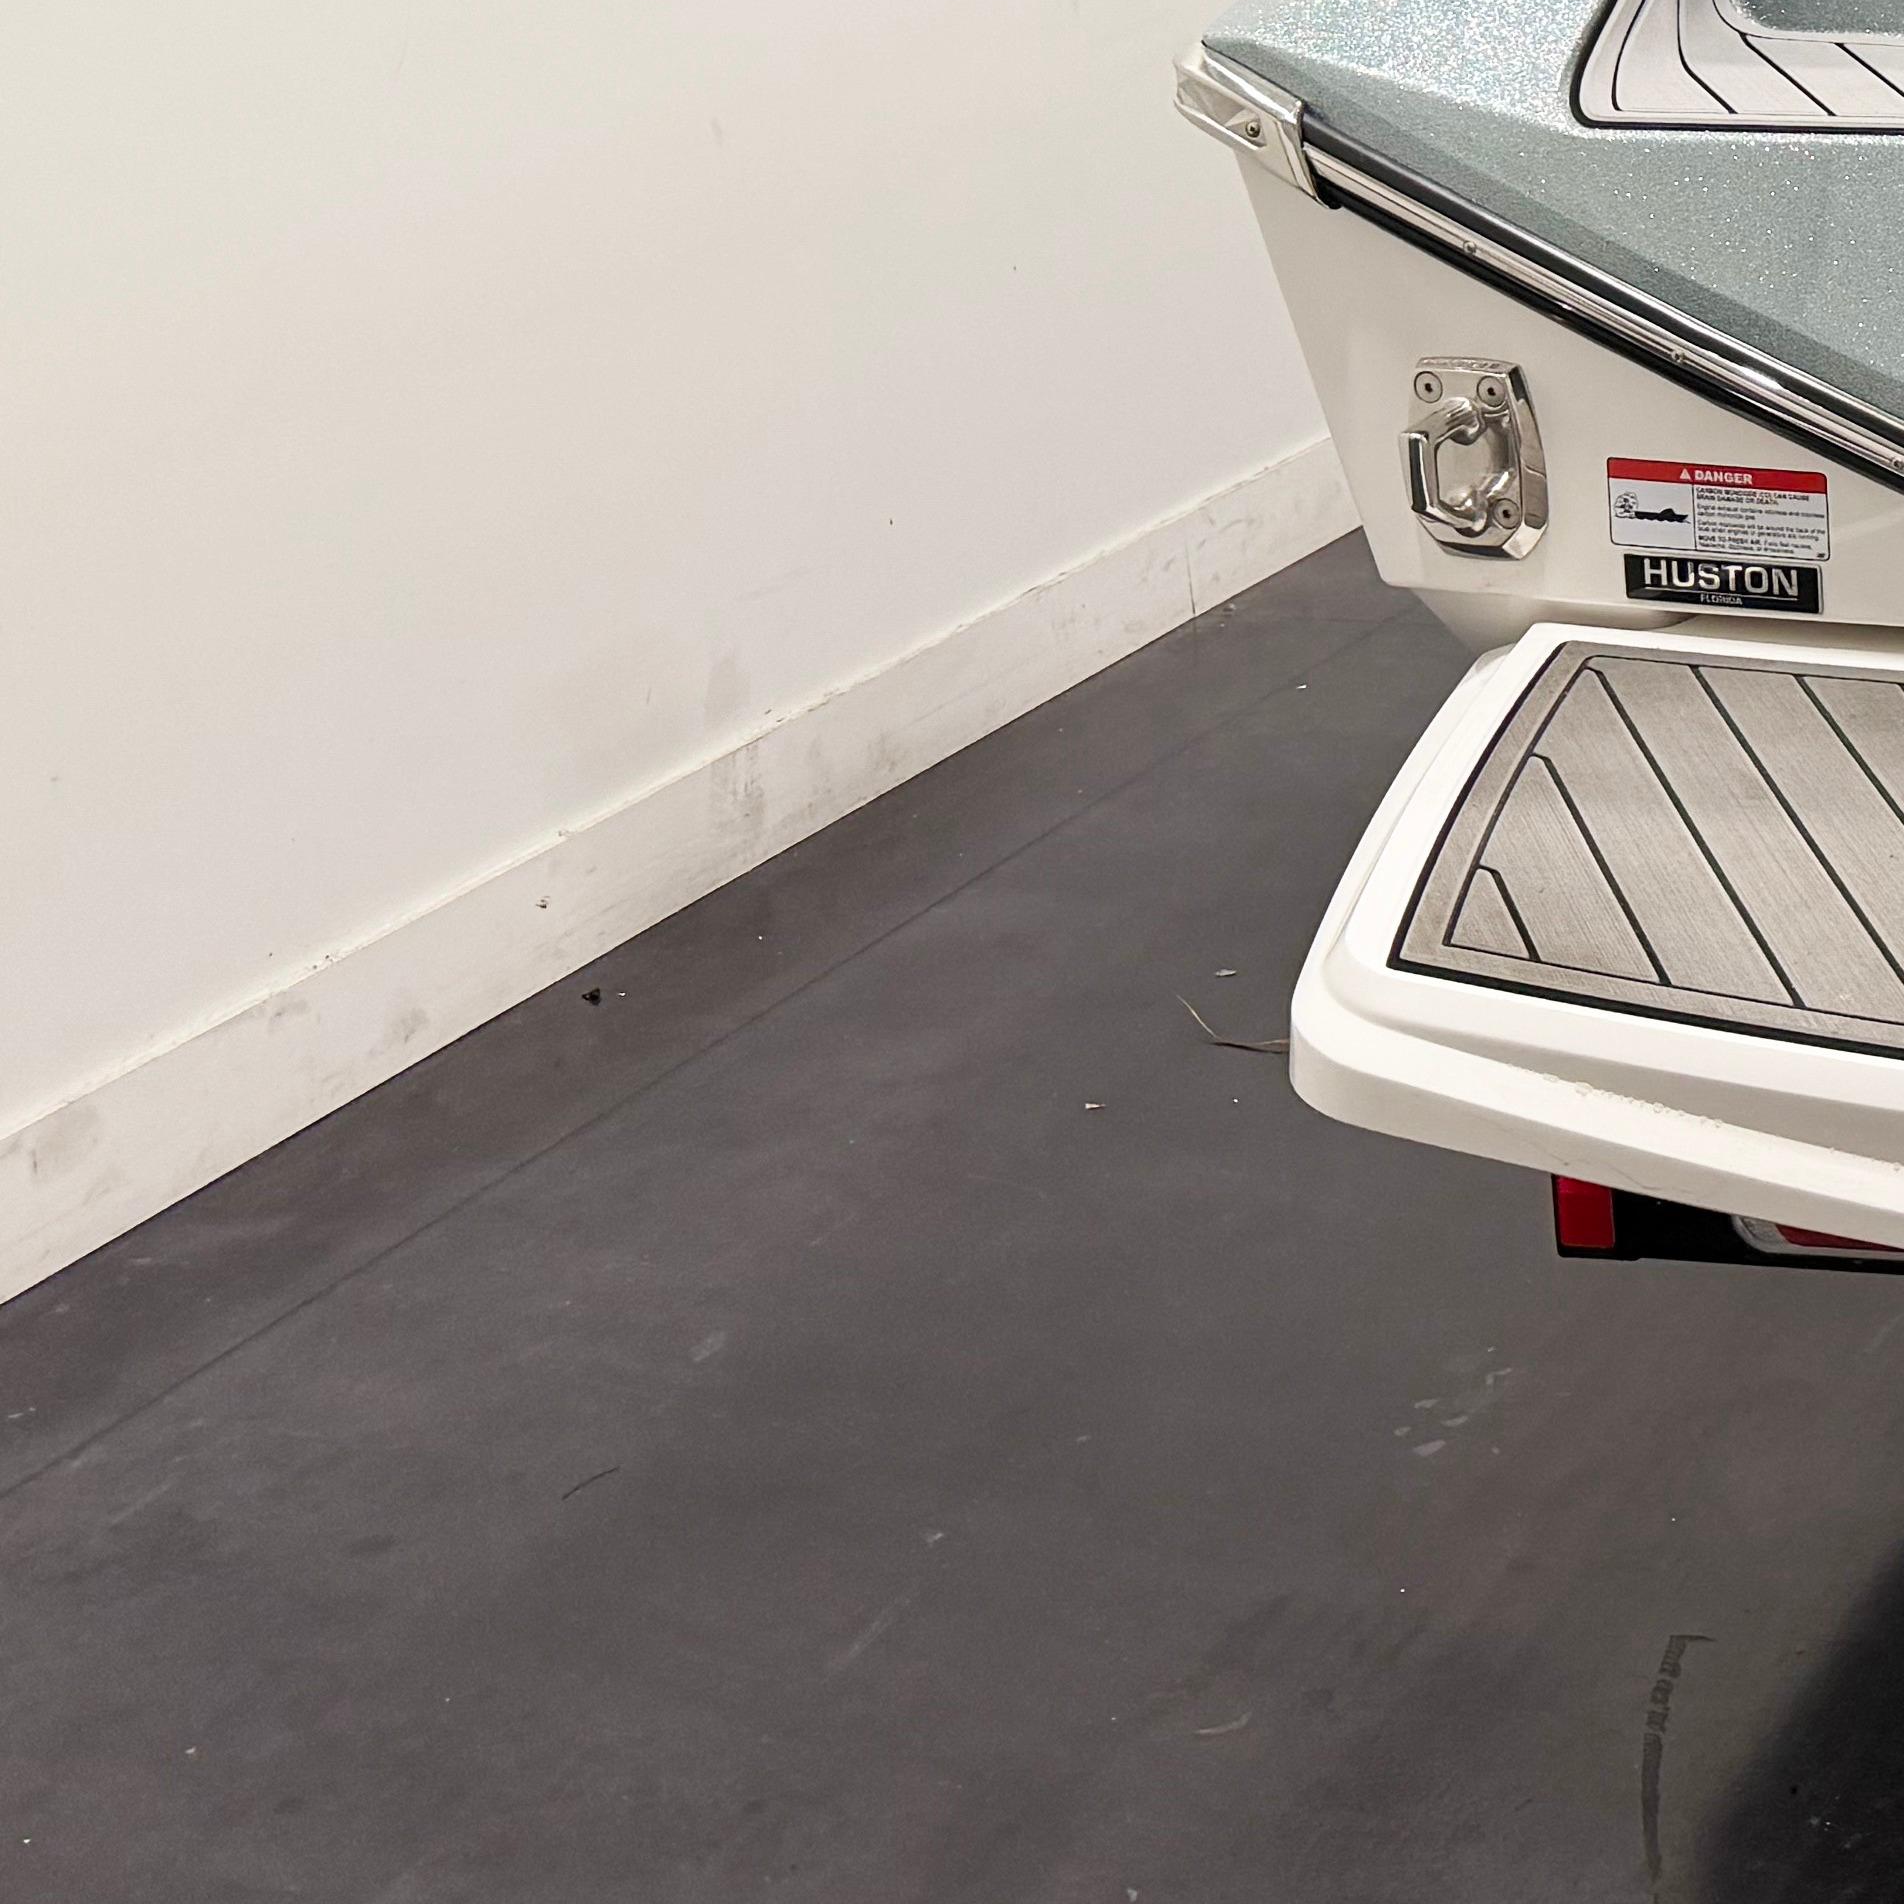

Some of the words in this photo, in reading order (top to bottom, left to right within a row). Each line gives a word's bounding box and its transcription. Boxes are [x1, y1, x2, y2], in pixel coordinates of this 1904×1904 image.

[1694, 470, 1753, 485] DANGER
[1643, 557, 1798, 597] HUSTON
[1700, 593, 1743, 605] FLORIDA
